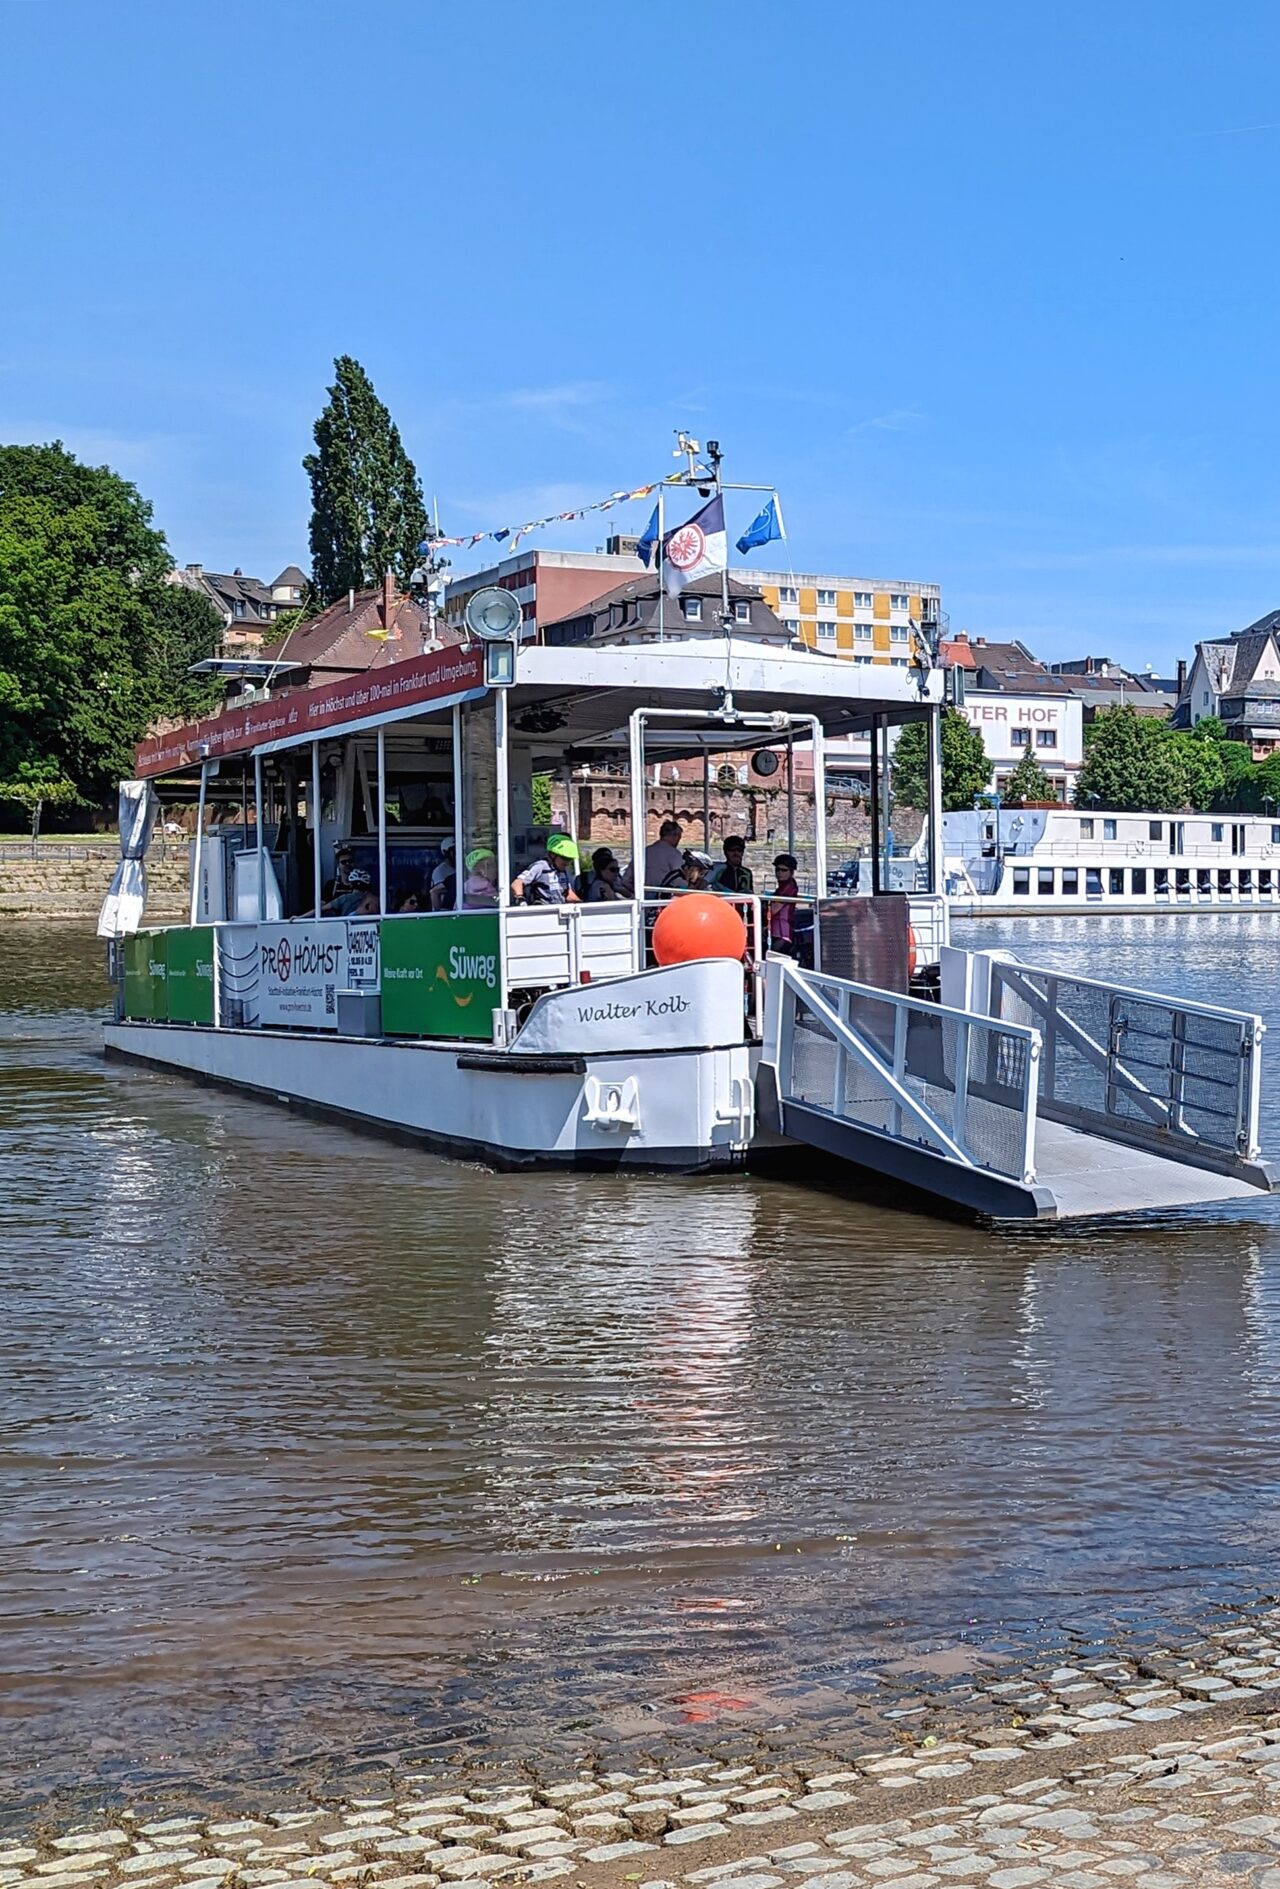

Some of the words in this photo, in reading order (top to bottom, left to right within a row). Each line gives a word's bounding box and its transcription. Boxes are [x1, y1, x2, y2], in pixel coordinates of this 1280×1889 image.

[308, 703, 320, 717] Hier
[320, 701, 325, 715] in
[325, 698, 345, 713] Höchst
[345, 694, 355, 708] und
[356, 690, 370, 706] über
[370, 680, 393, 701] 100-mal
[393, 680, 399, 694] in
[399, 672, 427, 692] Frankfurt
[427, 670, 441, 686] und
[440, 661, 478, 682] Umgebung.
[1018, 707, 1058, 722] HOF
[149, 959, 166, 980] Süwag
[294, 936, 343, 976] HÖCHST
[449, 945, 496, 988] Süwag
[577, 1003, 642, 1022] Walter
[645, 995, 691, 1016] Kolb
